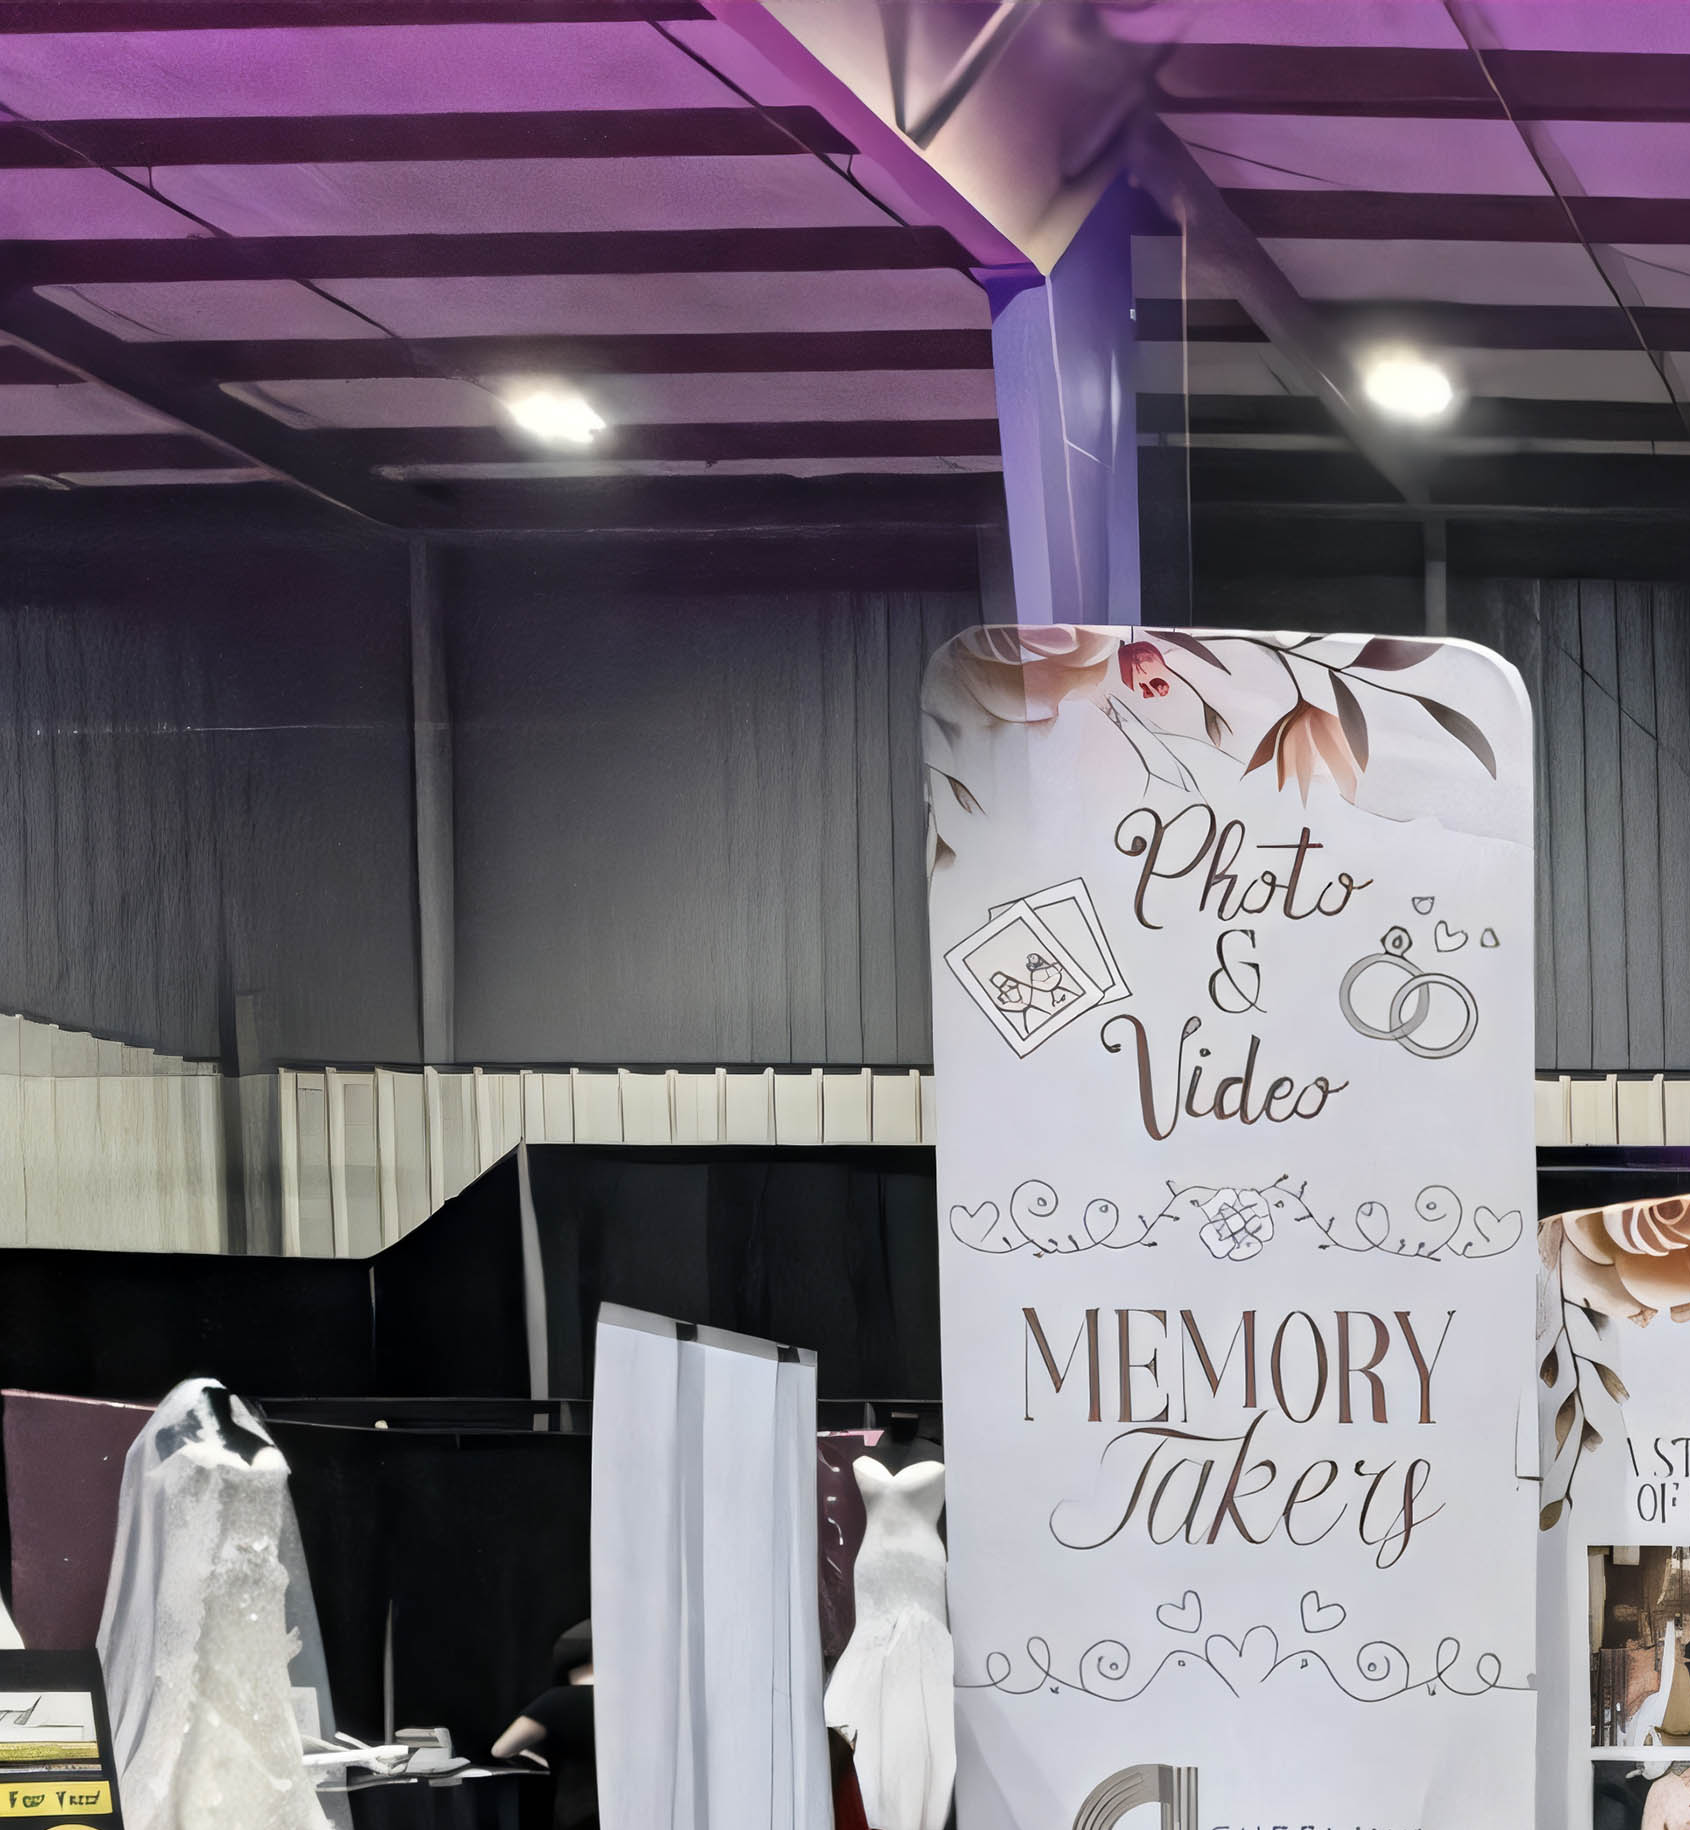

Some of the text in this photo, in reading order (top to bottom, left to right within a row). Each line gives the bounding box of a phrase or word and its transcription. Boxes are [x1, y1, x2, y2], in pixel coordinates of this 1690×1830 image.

[1114, 804, 1373, 929] Photo
[1208, 929, 1267, 1013] &
[1101, 1014, 1349, 1141] Video
[1022, 1307, 1456, 1425] MEMORY
[1049, 1409, 1446, 1569] Takers
